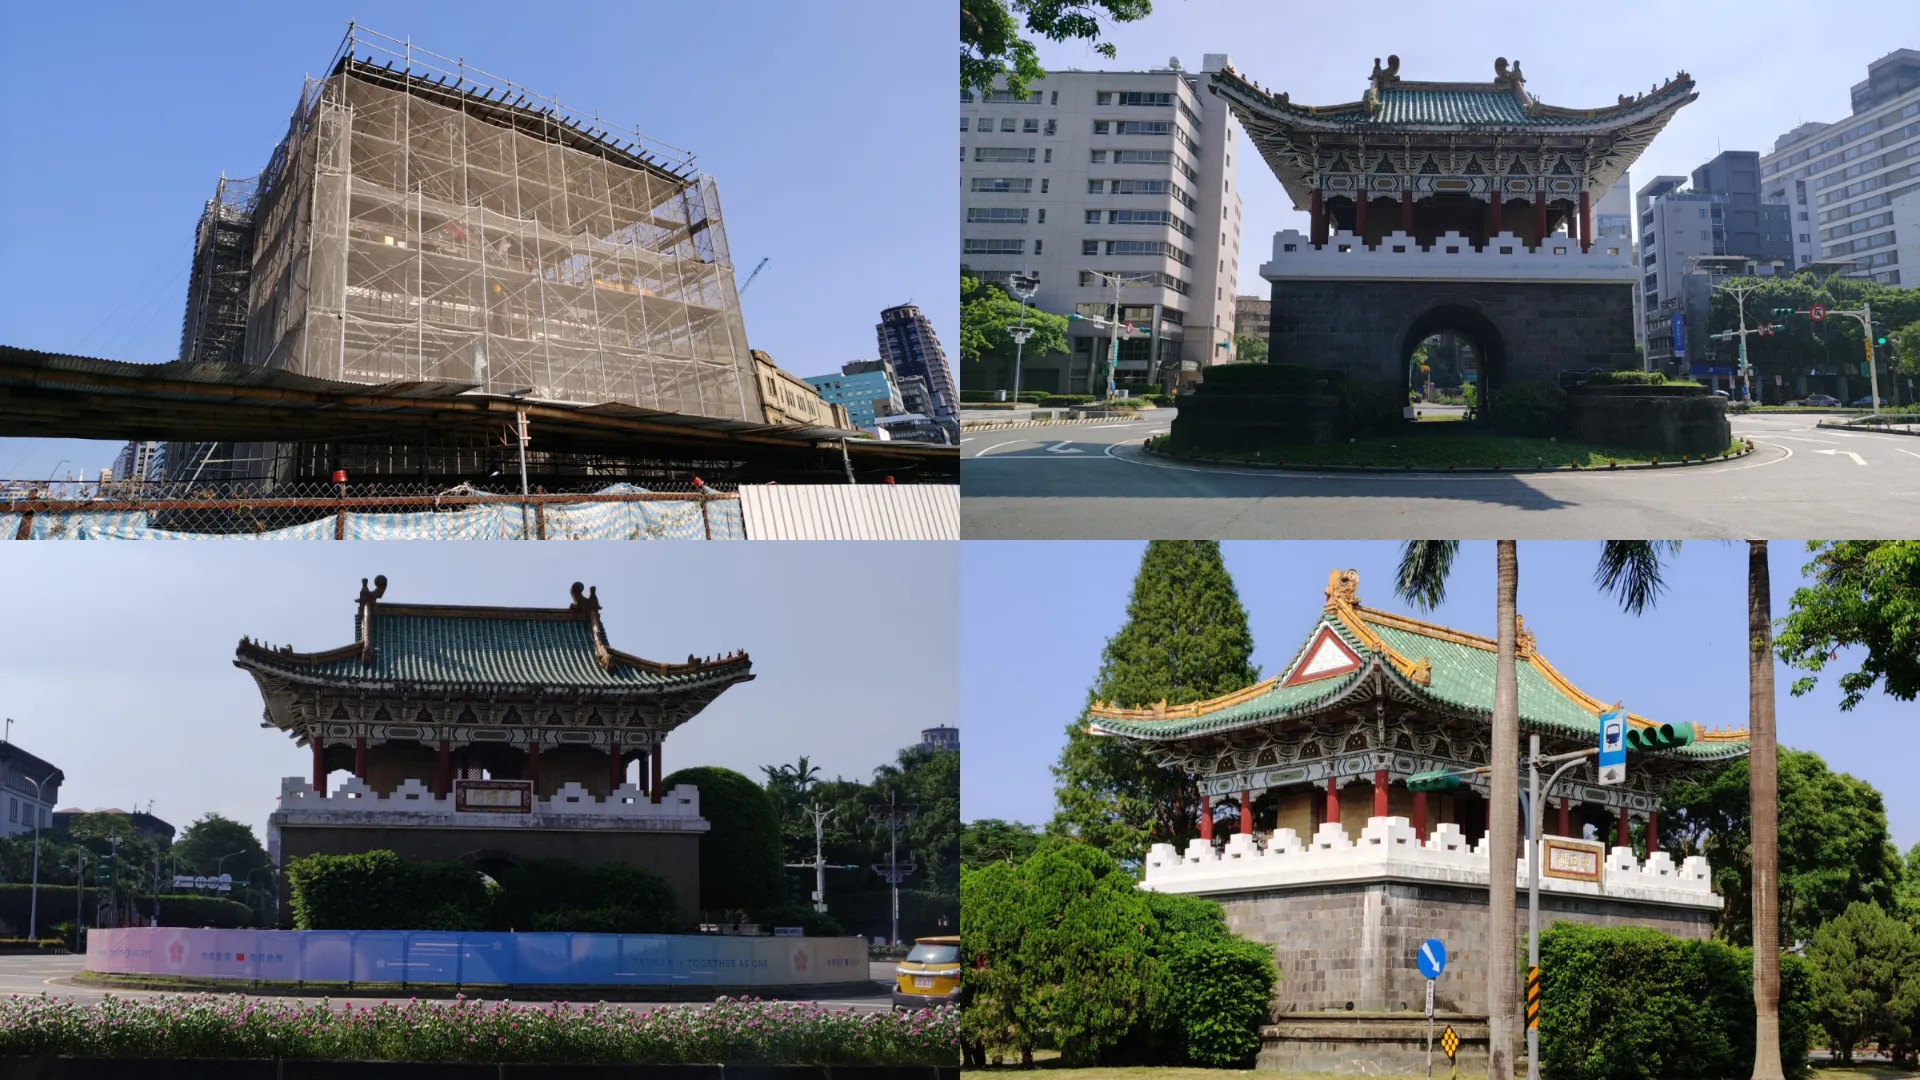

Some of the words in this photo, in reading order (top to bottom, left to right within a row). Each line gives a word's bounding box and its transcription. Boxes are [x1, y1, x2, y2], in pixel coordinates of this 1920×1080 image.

[632, 957, 674, 967] TAIWAN
[688, 958, 735, 968] TOGETHER
[739, 959, 749, 968] AS
[752, 959, 768, 968] ONE
